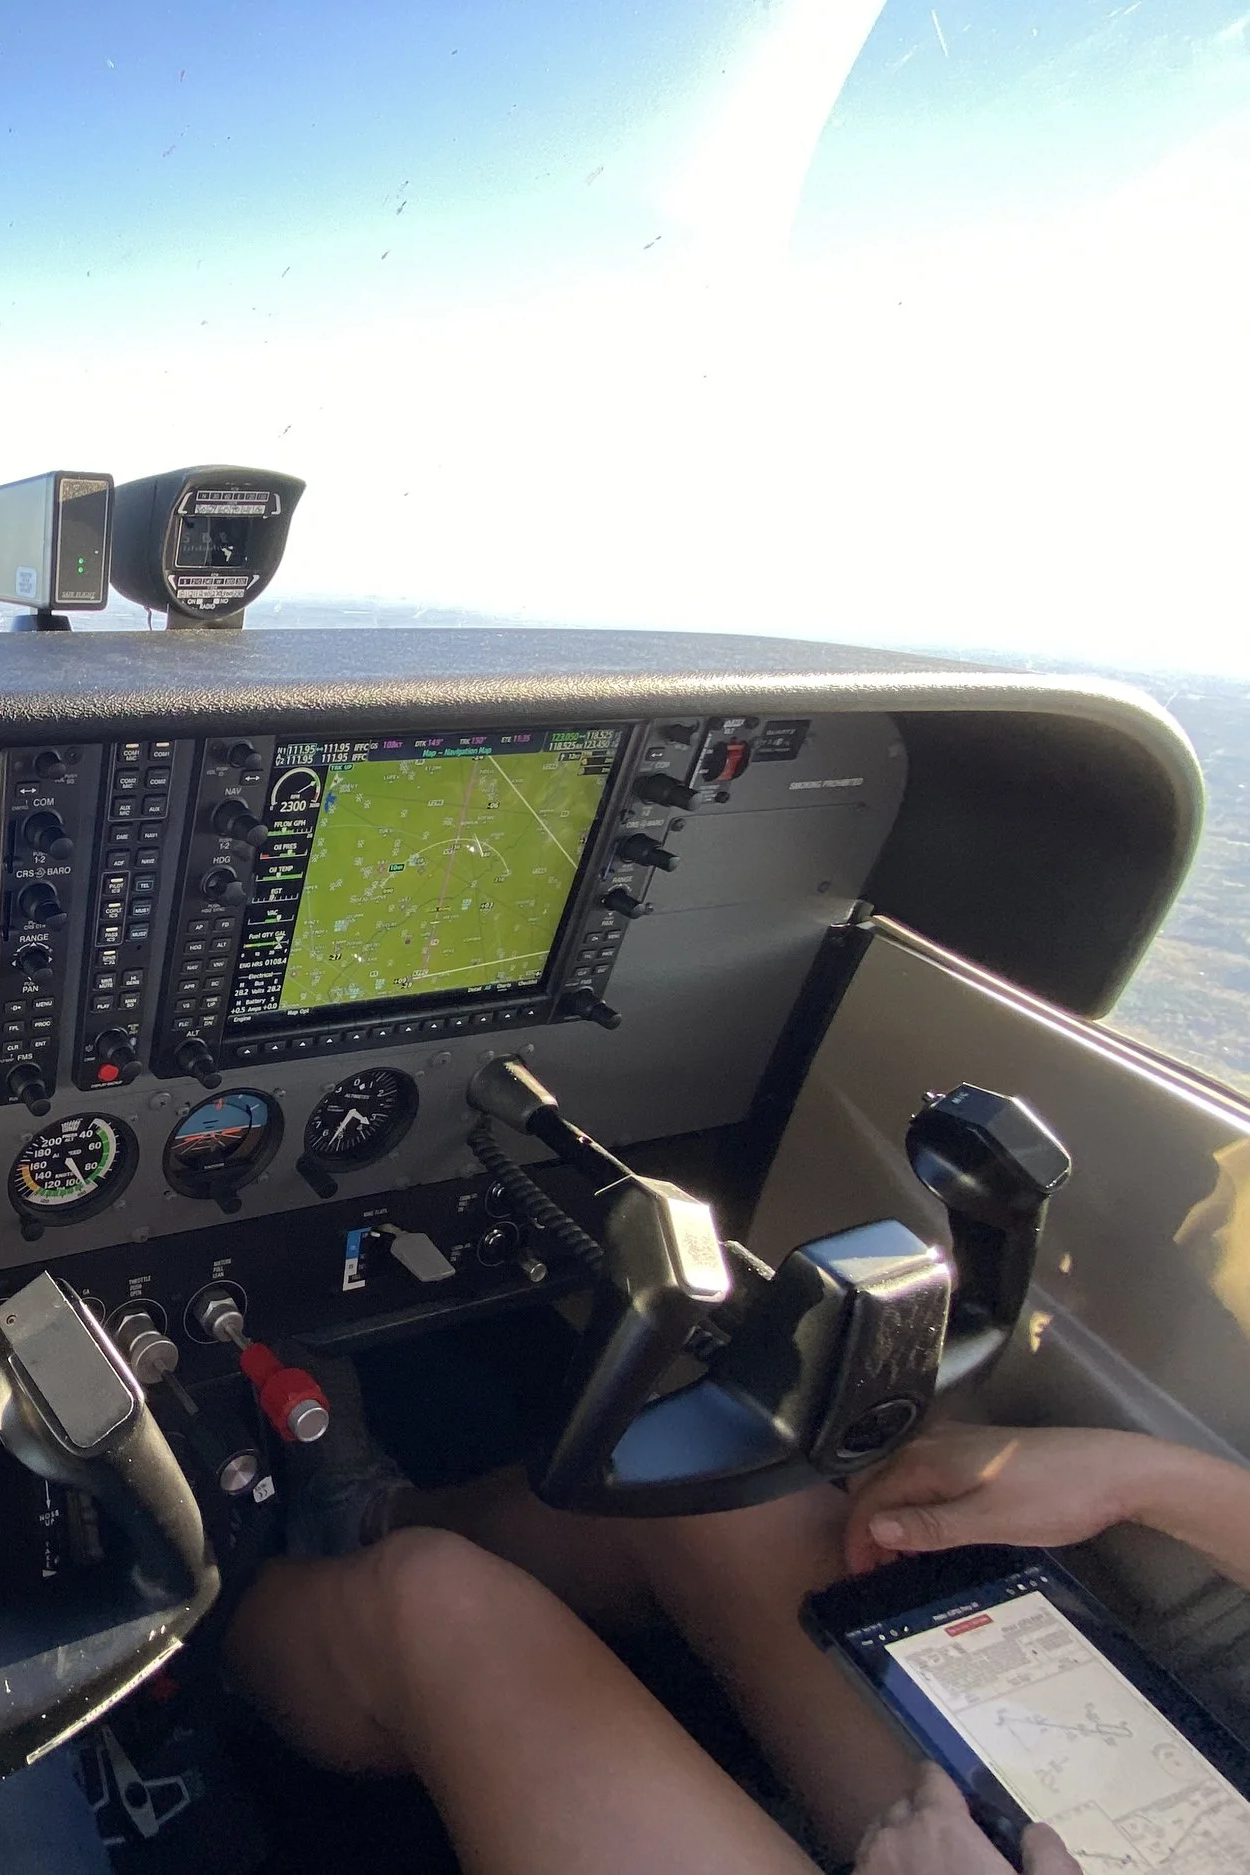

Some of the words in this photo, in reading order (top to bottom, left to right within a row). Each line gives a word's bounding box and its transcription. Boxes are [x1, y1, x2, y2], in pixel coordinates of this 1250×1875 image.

[289, 745, 315, 754] 111.95
[324, 743, 350, 752] 111.95
[286, 756, 313, 765] 111.95
[321, 754, 348, 762] 111.95
[33, 798, 55, 807] COM
[280, 801, 306, 812] 2300
[47, 867, 71, 876] BARO
[20, 934, 49, 942] RANGE
[22, 985, 39, 994] PAN
[17, 1053, 33, 1061] FMS
[79, 1130, 93, 1139] 40
[42, 1137, 62, 1148] 200
[89, 1142, 101, 1151] 60
[34, 1149, 51, 1158] 180
[30, 1161, 47, 1171] 160
[85, 1162, 98, 1171] 80
[35, 1171, 52, 1180] 140
[45, 1180, 61, 1189] 120
